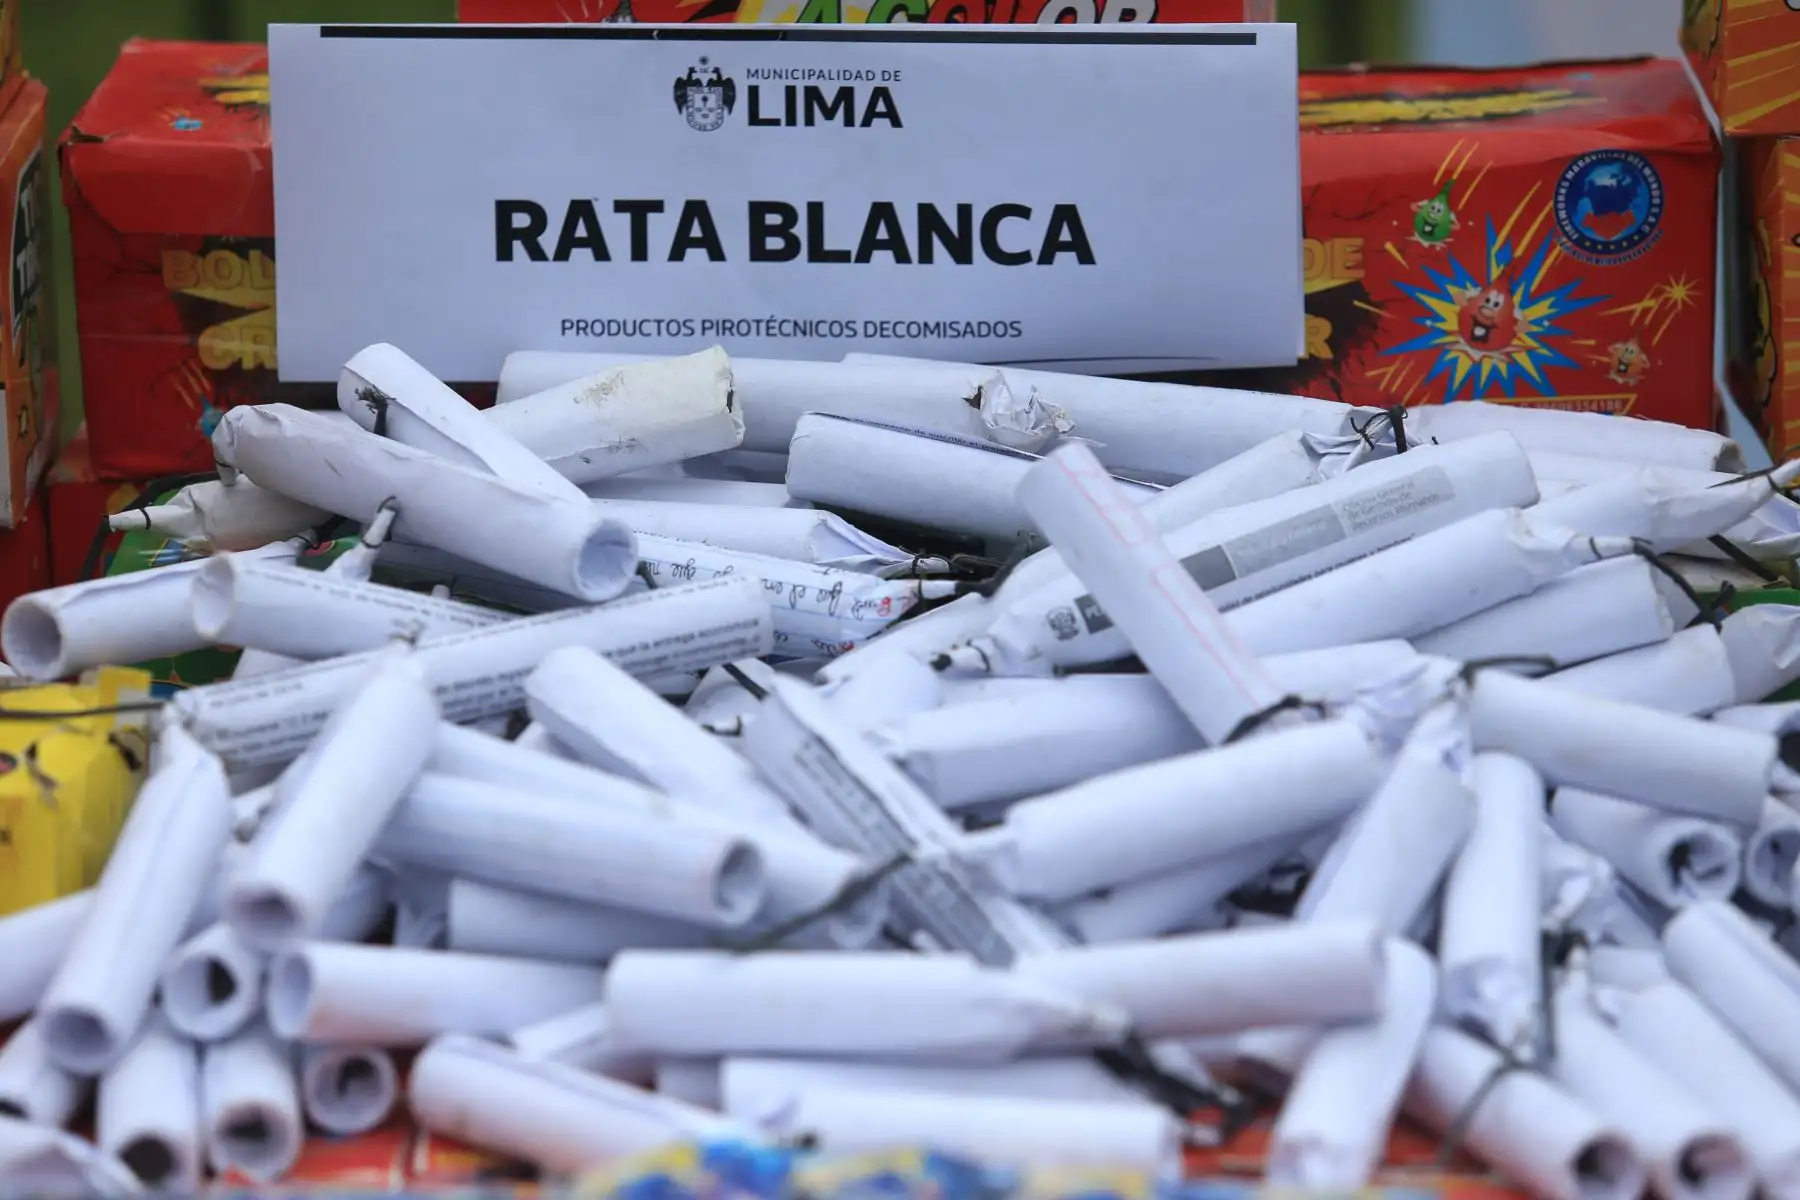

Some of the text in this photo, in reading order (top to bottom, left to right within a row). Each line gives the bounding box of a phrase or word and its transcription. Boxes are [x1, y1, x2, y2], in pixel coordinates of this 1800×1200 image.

[746, 68, 902, 81] MUNICIPALIDAD DE
[747, 85, 904, 129] LIMA
[494, 199, 1097, 266] RATA BLANCA
[561, 314, 1023, 338] PRODUCTOS PIROTÉCNICOS DECOMISADOS
